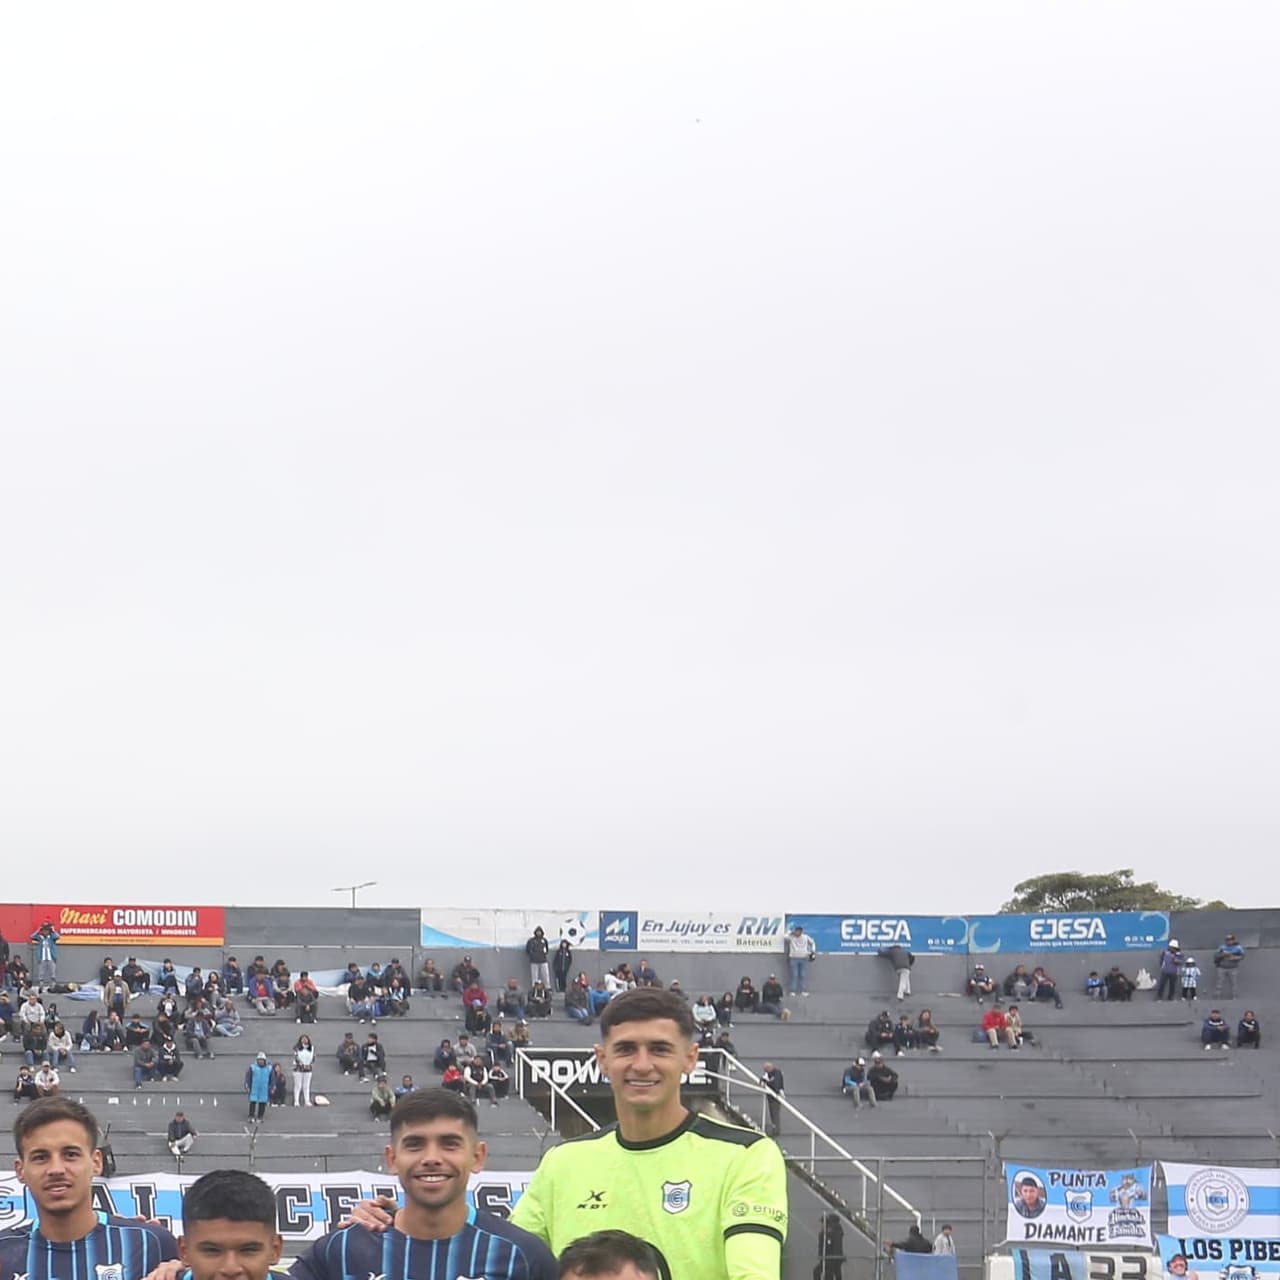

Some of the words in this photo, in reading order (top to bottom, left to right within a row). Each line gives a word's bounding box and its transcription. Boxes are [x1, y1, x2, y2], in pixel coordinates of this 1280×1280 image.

[60, 907, 109, 925] Maxi
[113, 909, 197, 926] COMODIN
[737, 916, 783, 936] RM
[641, 919, 664, 933] En
[666, 920, 710, 936] Jujuy
[713, 923, 732, 934] es
[841, 919, 912, 941] EJESA
[1030, 917, 1107, 940] EJESA
[1048, 1170, 1107, 1188] PUNTA
[1024, 1222, 1107, 1242] DIAMANTE
[1178, 1238, 1223, 1260] LOS
